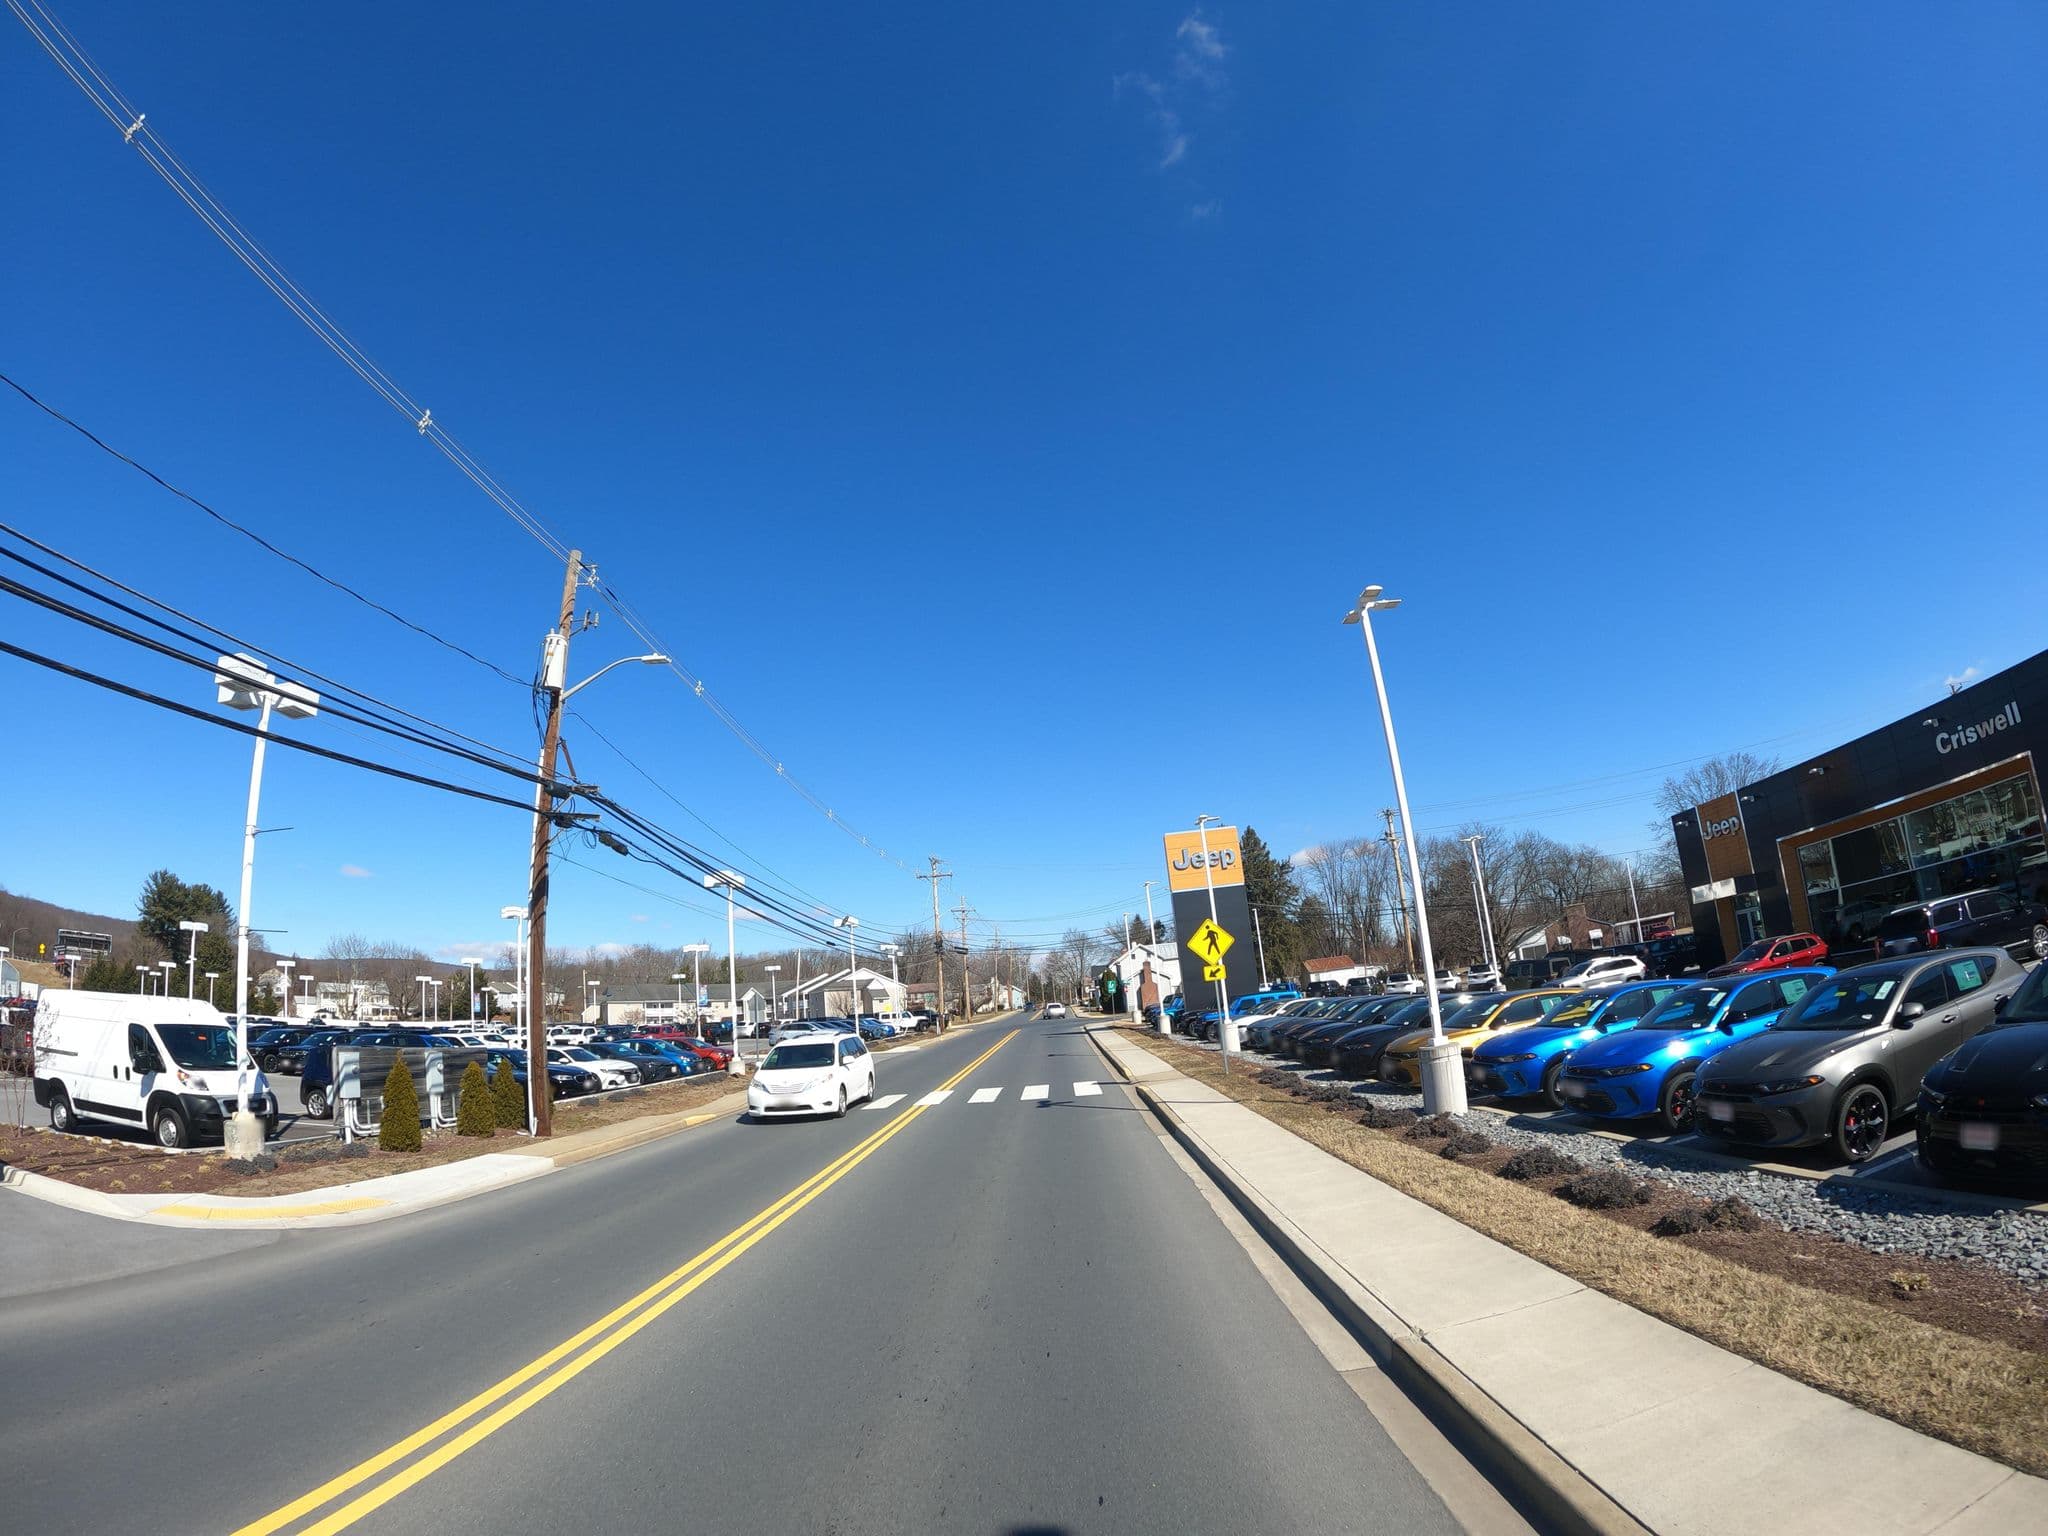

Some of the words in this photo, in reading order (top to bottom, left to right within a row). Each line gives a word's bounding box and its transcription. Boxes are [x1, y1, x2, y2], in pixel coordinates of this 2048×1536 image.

[1935, 701, 2021, 754] Criswell
[1703, 816, 1740, 840] Jeep
[1173, 848, 1236, 870] Jeep
